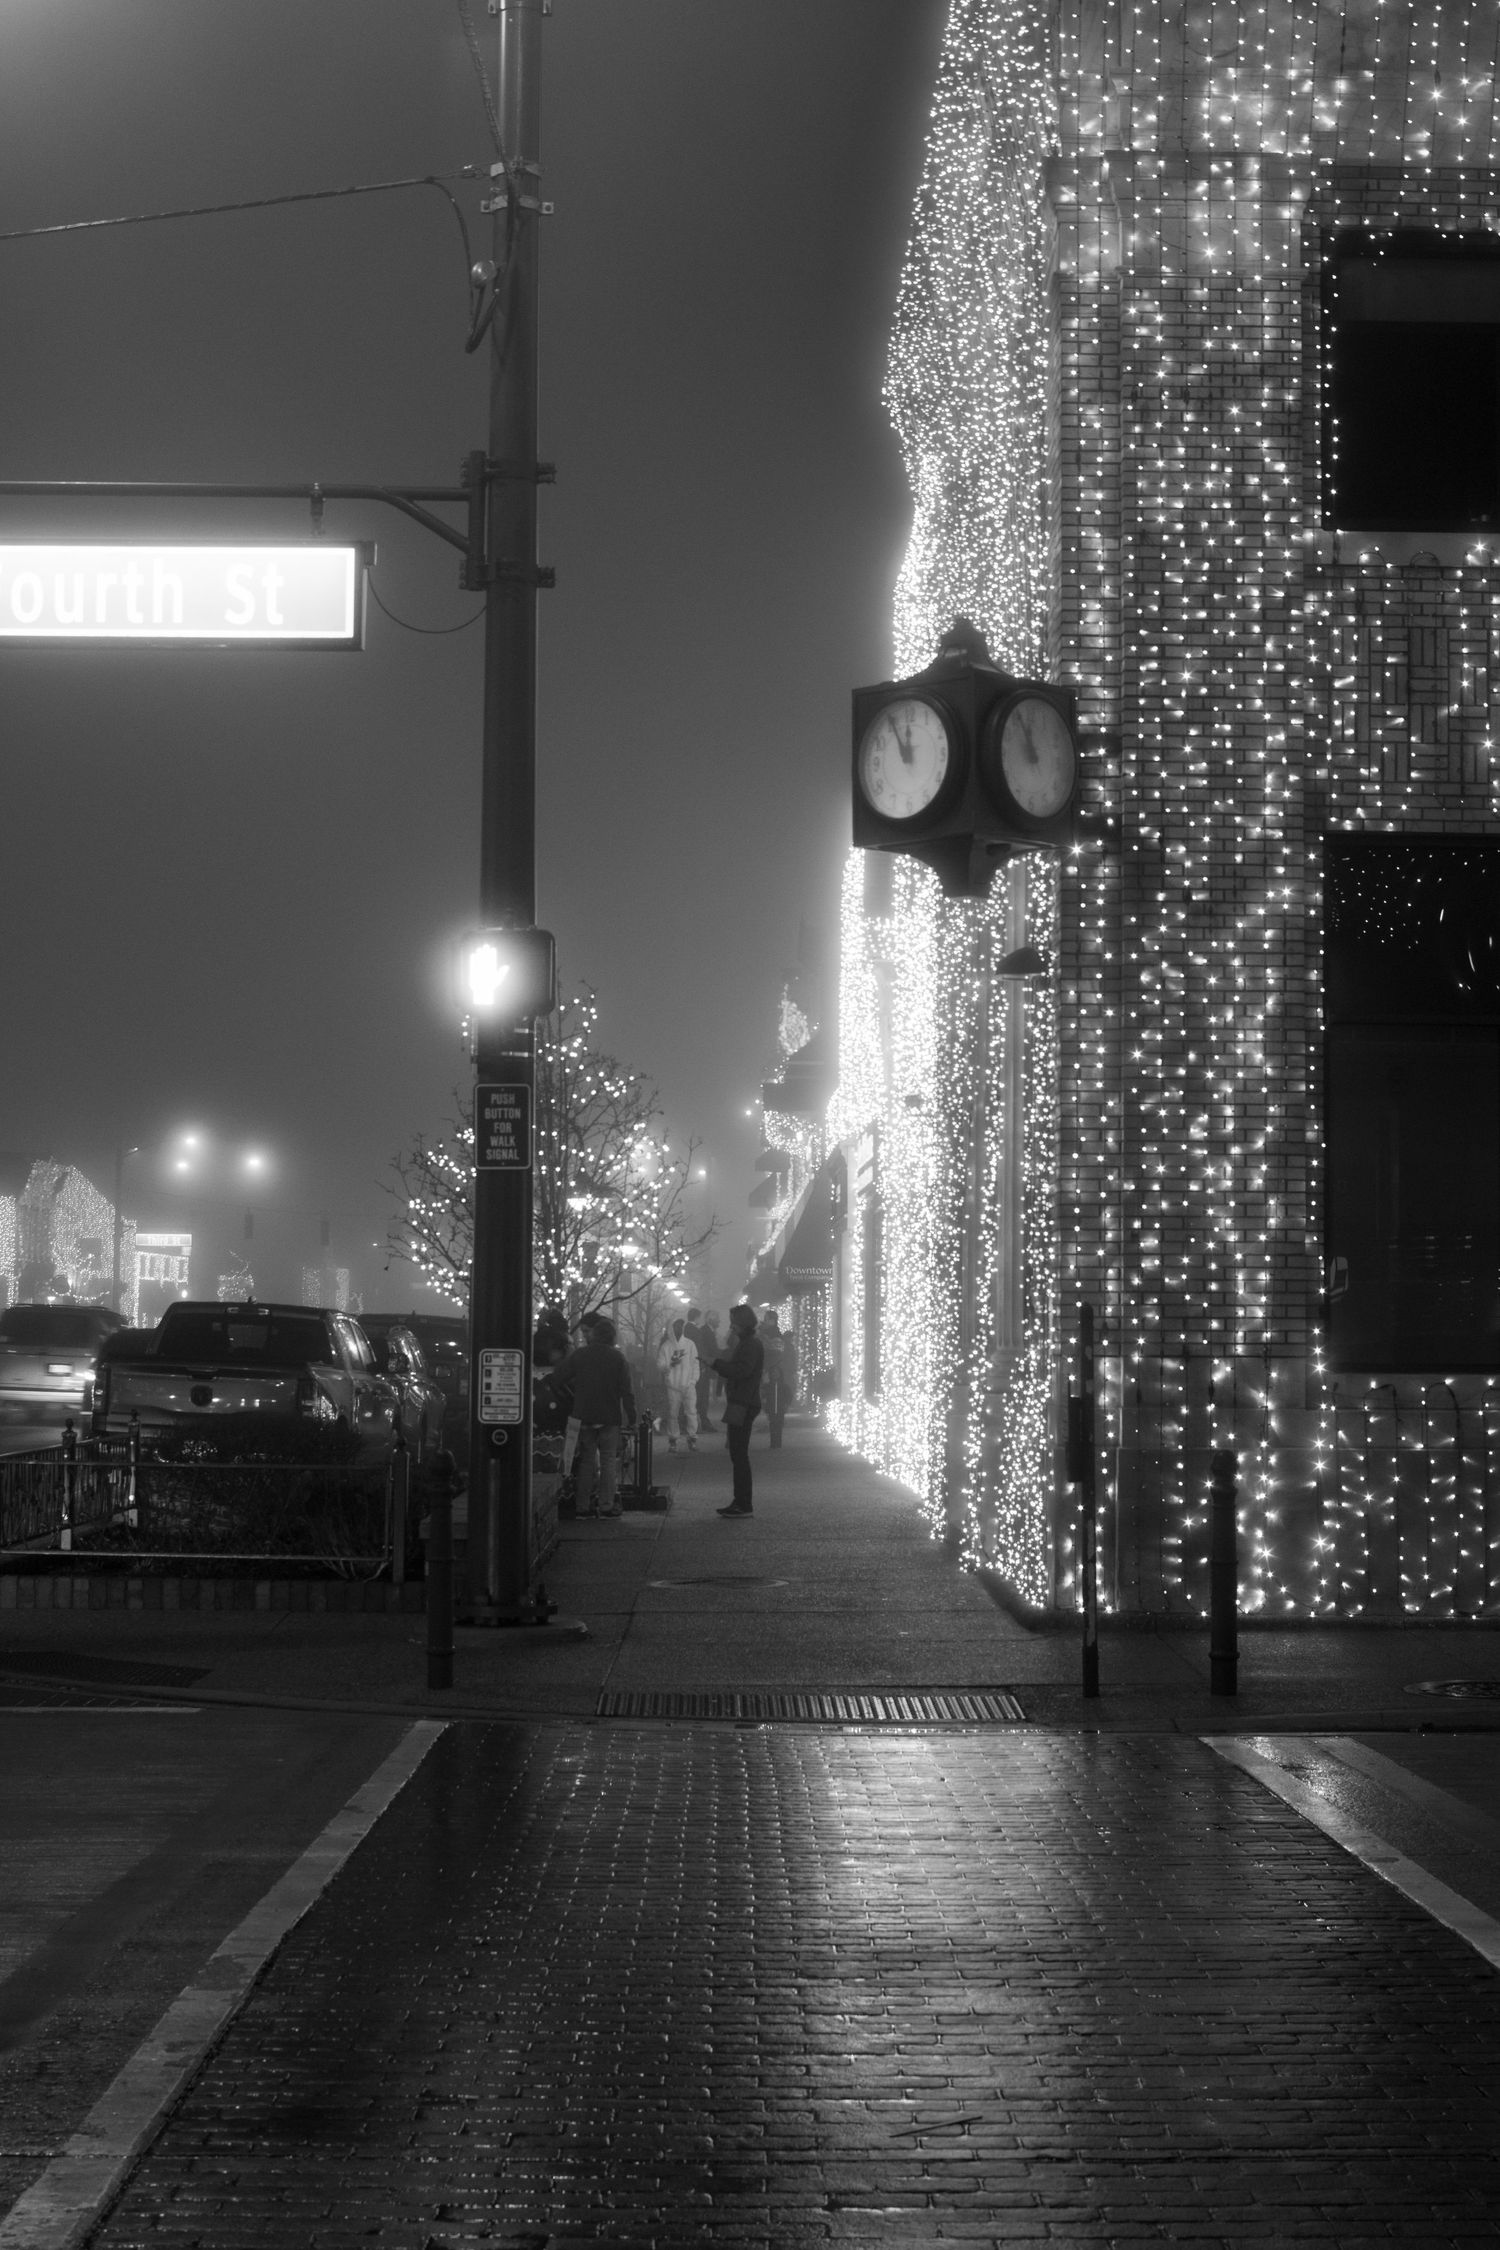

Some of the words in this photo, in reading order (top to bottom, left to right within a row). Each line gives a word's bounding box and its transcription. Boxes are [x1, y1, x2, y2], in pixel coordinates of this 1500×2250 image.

[0, 557, 183, 624] ourth
[224, 561, 285, 625] St
[491, 1093, 515, 1105] PUSH
[484, 1107, 521, 1120] BUTTON
[494, 1121, 513, 1134] FOR
[490, 1135, 516, 1148] WALK
[486, 1148, 520, 1161] SIGNAL
